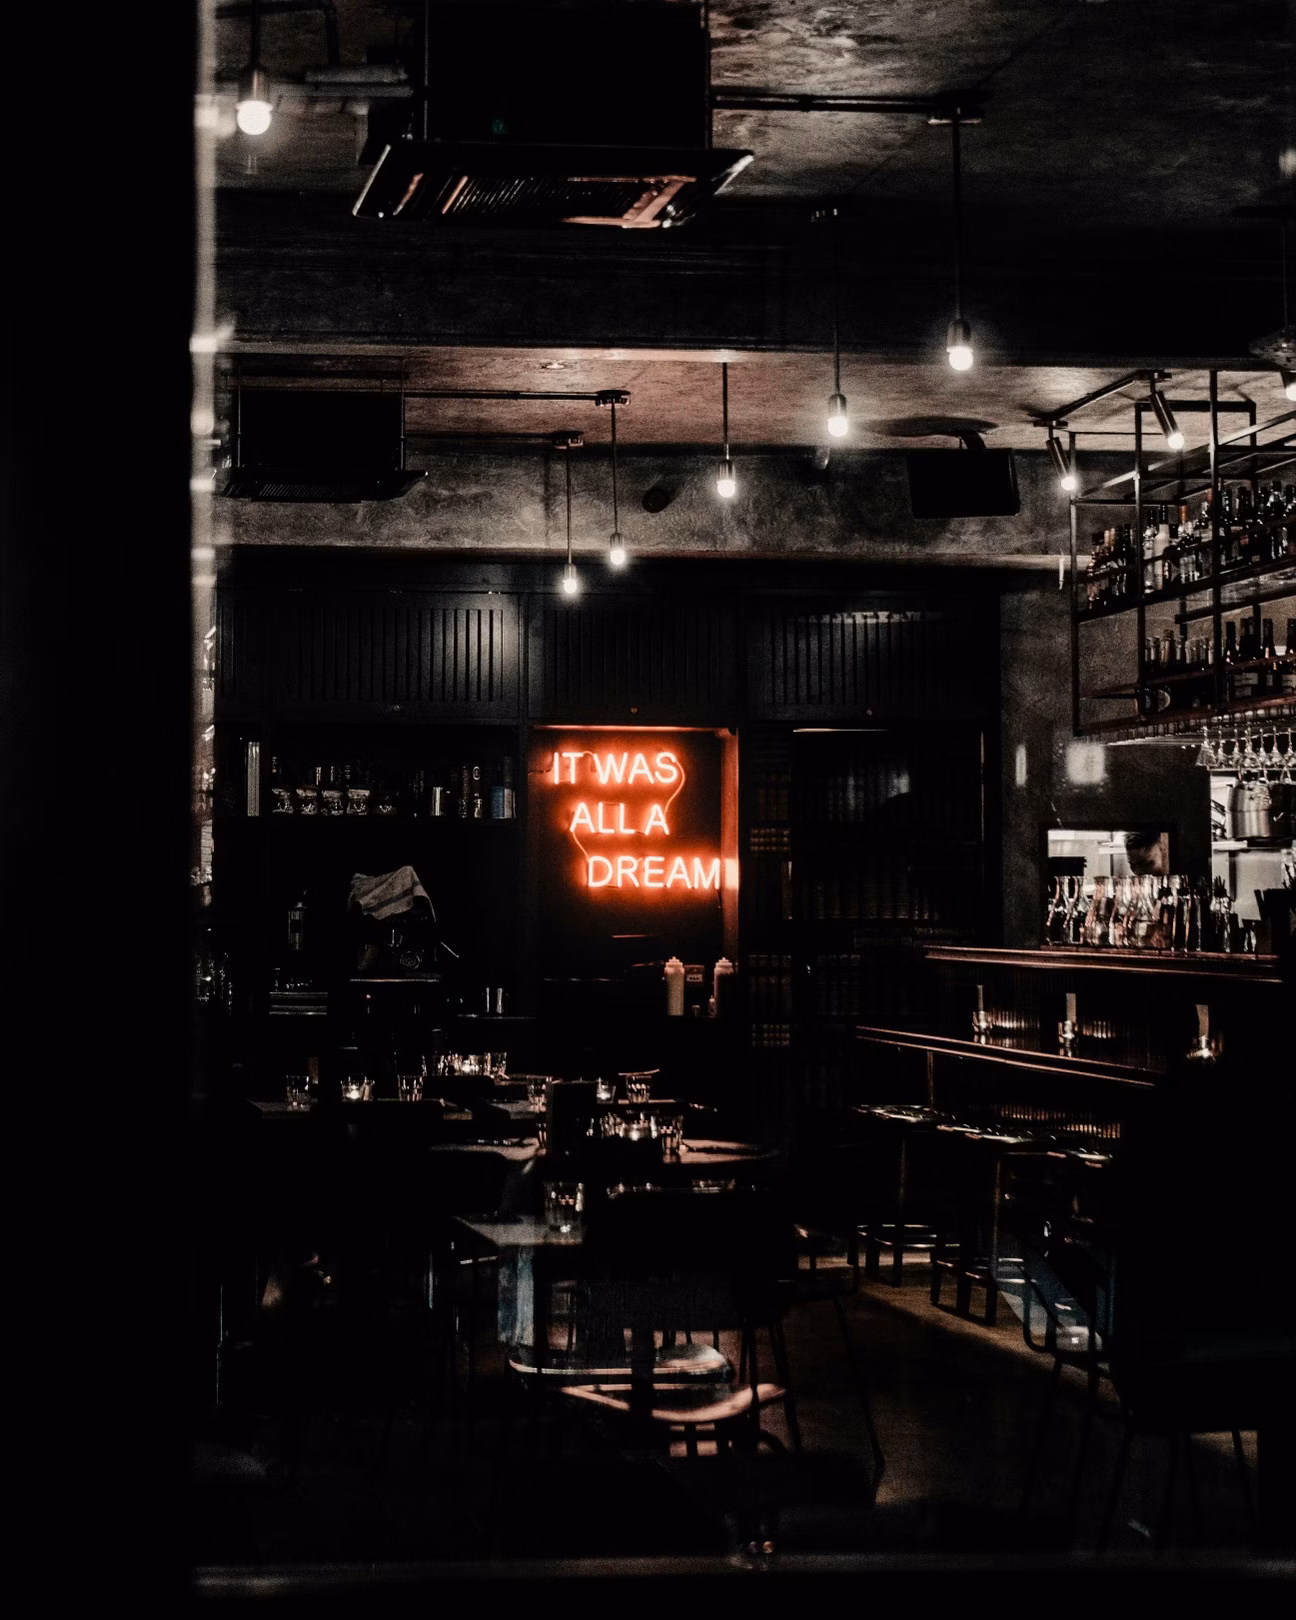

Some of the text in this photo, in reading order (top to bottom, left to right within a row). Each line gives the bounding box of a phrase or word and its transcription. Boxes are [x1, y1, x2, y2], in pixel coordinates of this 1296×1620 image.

[553, 751, 679, 785] IT WAS
[569, 801, 670, 836] ALL A
[587, 855, 721, 890] DREAM
